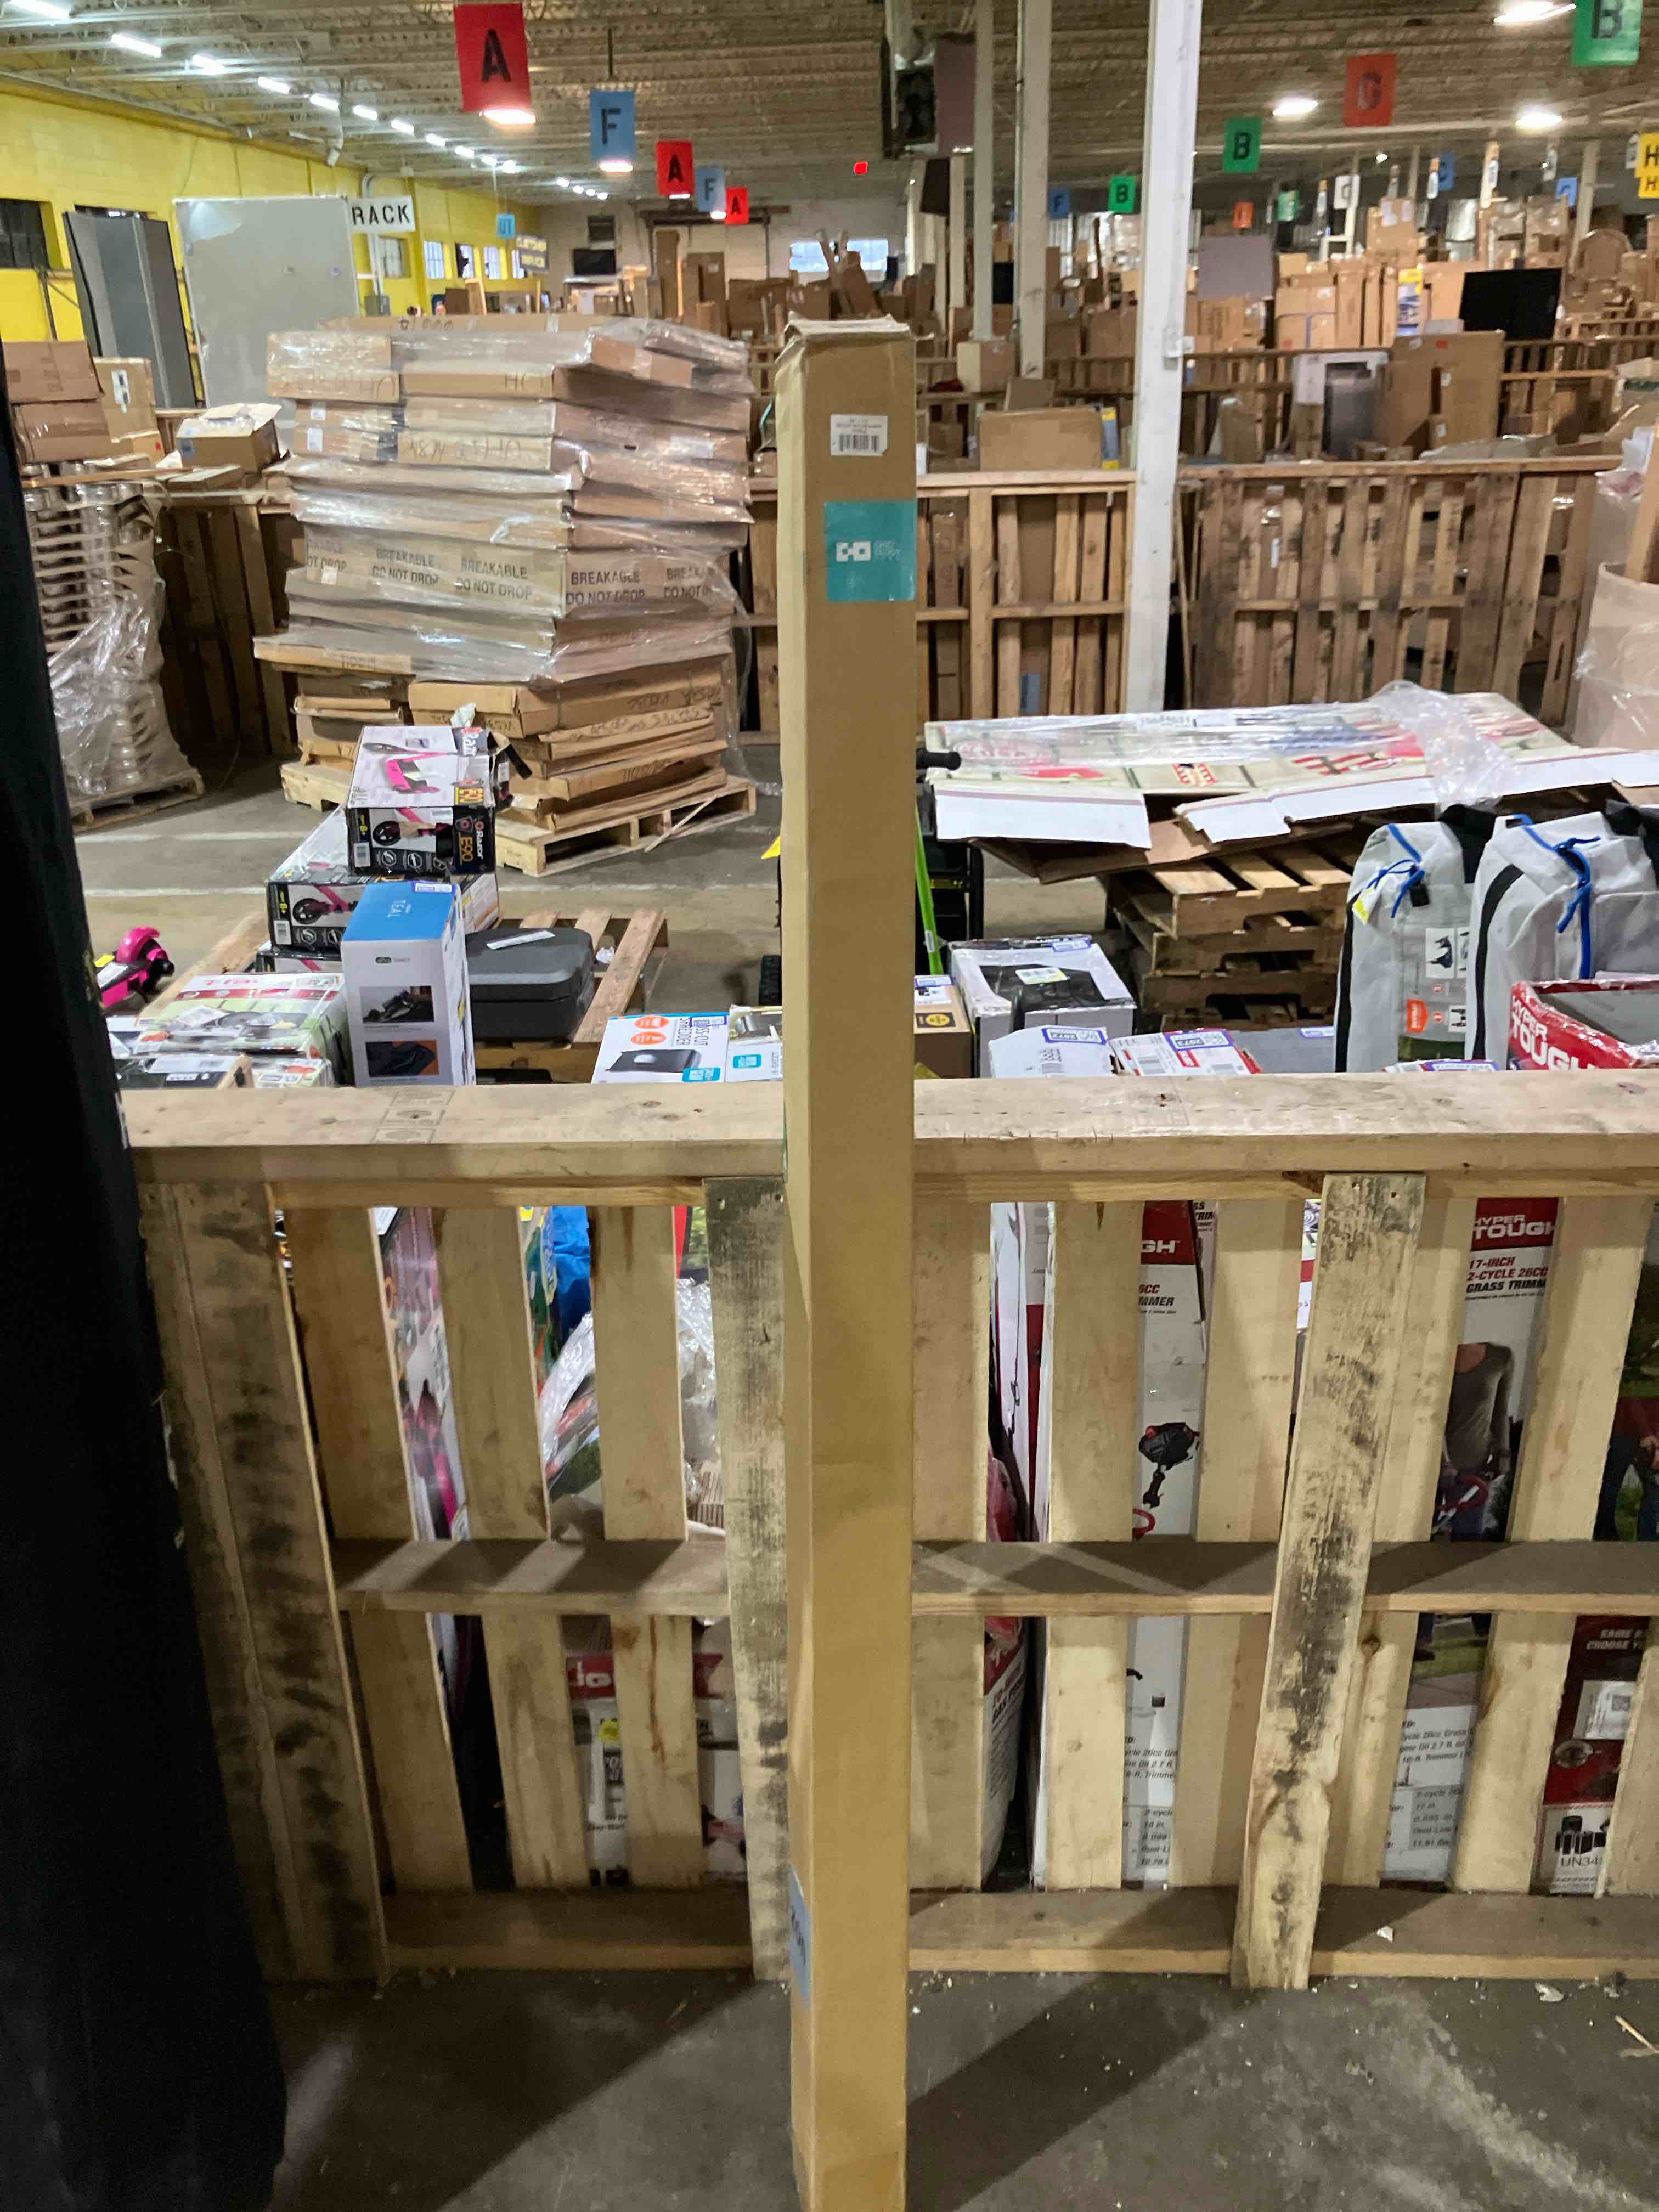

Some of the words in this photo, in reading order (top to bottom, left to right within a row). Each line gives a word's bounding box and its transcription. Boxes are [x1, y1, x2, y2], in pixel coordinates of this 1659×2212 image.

[1591, 0, 1623, 39] B
[482, 28, 511, 83] A
[601, 108, 621, 145] F
[1233, 132, 1251, 159] B
[1645, 145, 1658, 166] H
[667, 154, 684, 184] A
[704, 178, 715, 201] F
[1116, 184, 1128, 202] B
[731, 196, 742, 216] A
[1054, 194, 1065, 212] F
[352, 204, 410, 226] RACK
[388, 567, 409, 582] NOT
[410, 572, 439, 585] DROP
[461, 557, 528, 580] BREAKABLE
[571, 568, 641, 585] BREAKABLE
[455, 578, 471, 590] DO
[472, 582, 496, 595] NOT
[498, 583, 533, 601] DROP
[566, 591, 585, 605] DO
[589, 591, 611, 604] NOT
[614, 589, 646, 602] DROP
[460, 836, 474, 862] E90
[1511, 996, 1548, 1042] HYPER
[1475, 1214, 1526, 1226] HYPER
[1470, 1256, 1516, 1269] 17-INCH
[1466, 1268, 1516, 1282] 2-CYCLE
[1517, 1267, 1549, 1278] 26CC
[1466, 1281, 1505, 1293] GRASS
